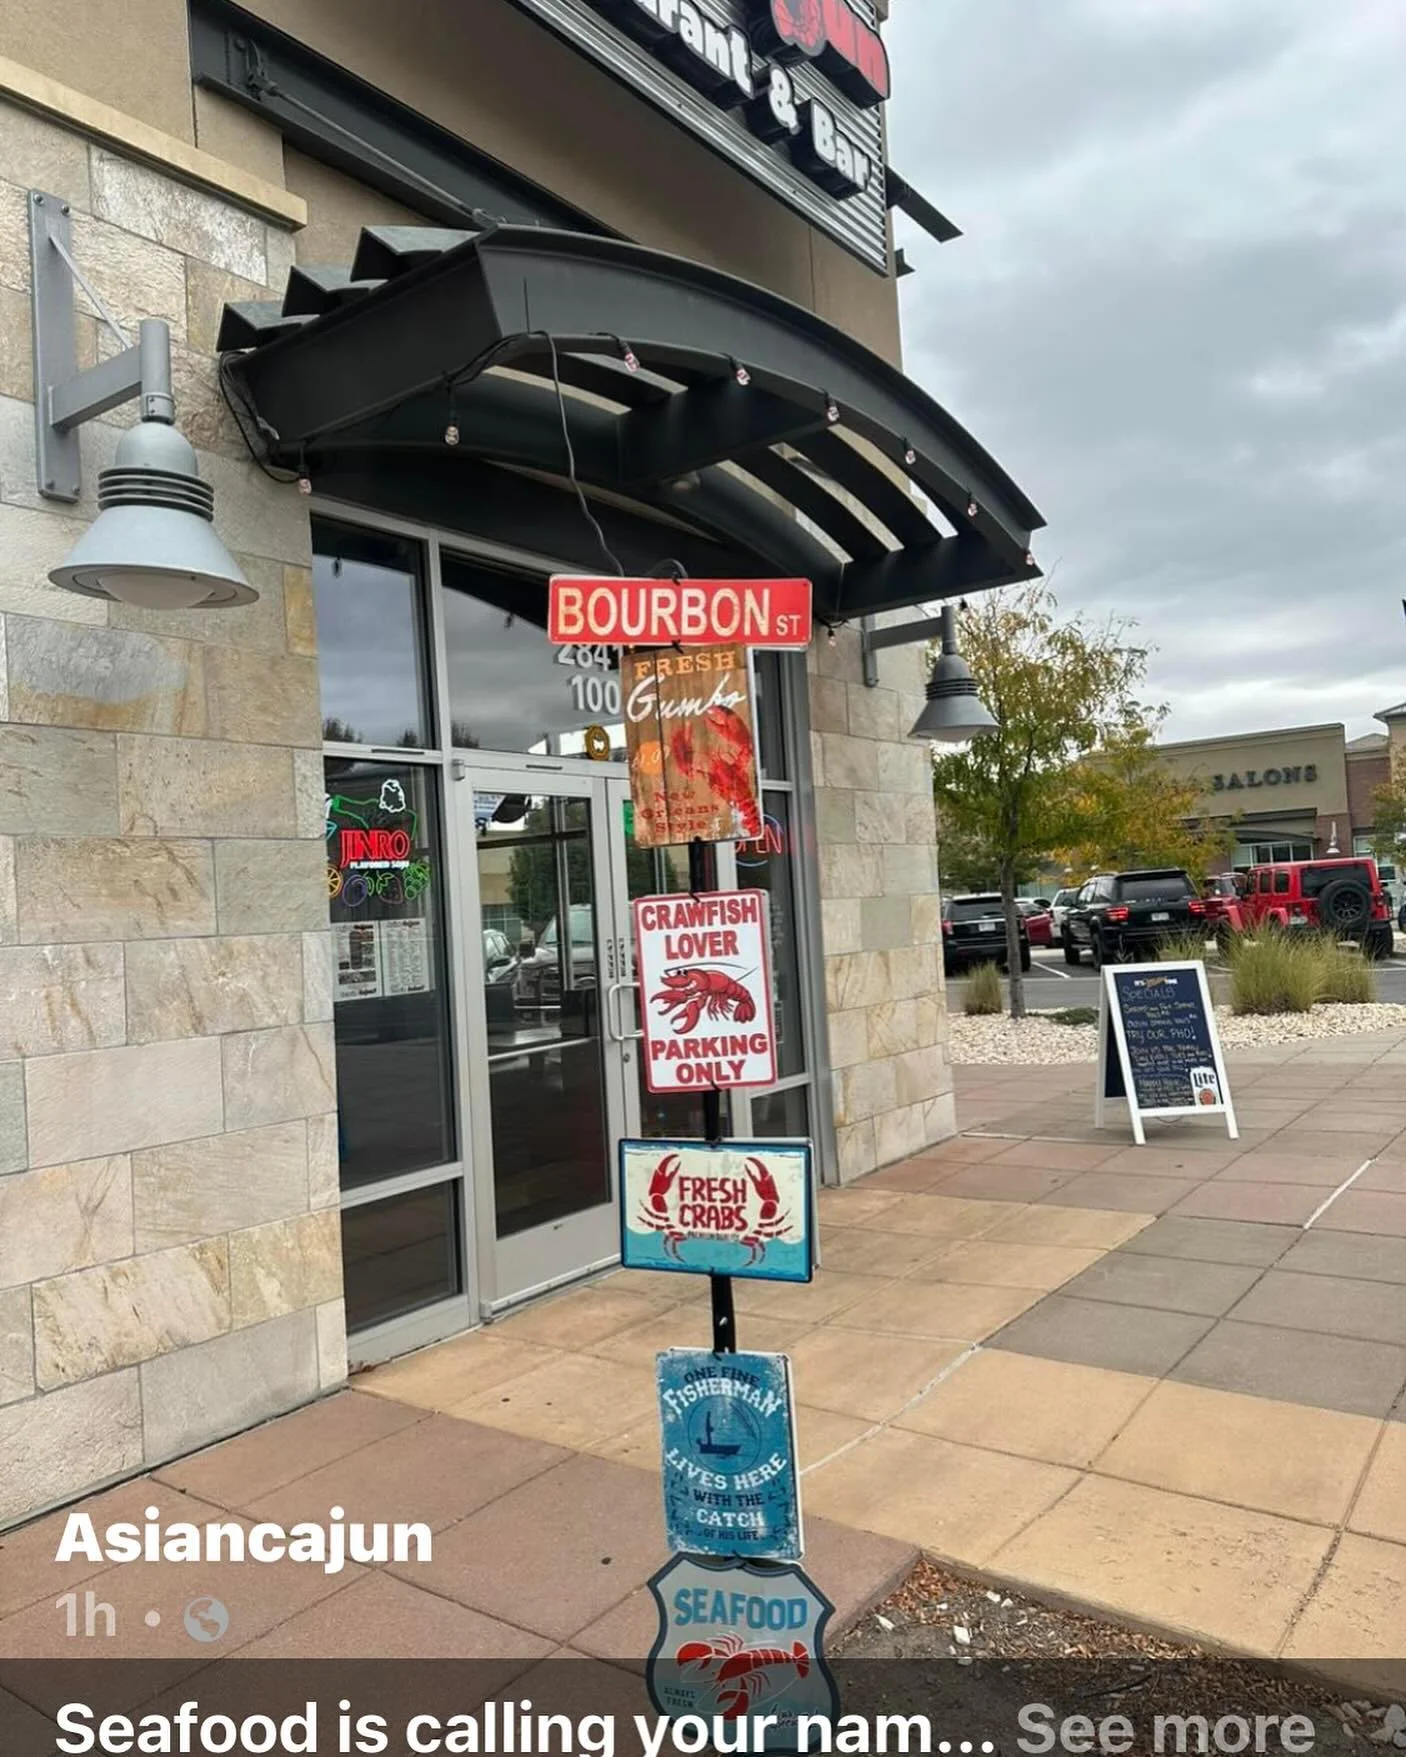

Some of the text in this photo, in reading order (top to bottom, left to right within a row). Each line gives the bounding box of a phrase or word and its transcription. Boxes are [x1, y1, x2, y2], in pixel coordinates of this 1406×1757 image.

[638, 0, 869, 191] rant & Bar
[557, 587, 801, 637] BOURBON ST
[633, 650, 737, 679] FRESH
[571, 674, 620, 715] 100
[627, 672, 747, 723] Gumbo
[1212, 763, 1318, 792] SALONS
[654, 790, 696, 802] New
[641, 803, 719, 820] Orleans
[654, 818, 707, 834] Style
[339, 828, 412, 869] JINRO
[641, 897, 758, 931] CRAWFISH
[665, 930, 740, 960] LOVER
[651, 1033, 768, 1060] PARKING
[676, 1059, 746, 1084] ONLY
[1193, 1071, 1216, 1088] Lite
[678, 1176, 747, 1204] FRESH
[678, 1203, 748, 1232] CRABS
[684, 1366, 760, 1387] ONE FINE
[663, 1377, 784, 1417] FISHERMAN
[665, 1447, 787, 1490] LIVES HERE
[694, 1488, 765, 1506] WITH THE
[696, 1508, 765, 1527] CATCH
[673, 1587, 809, 1631] SEAFOOD
